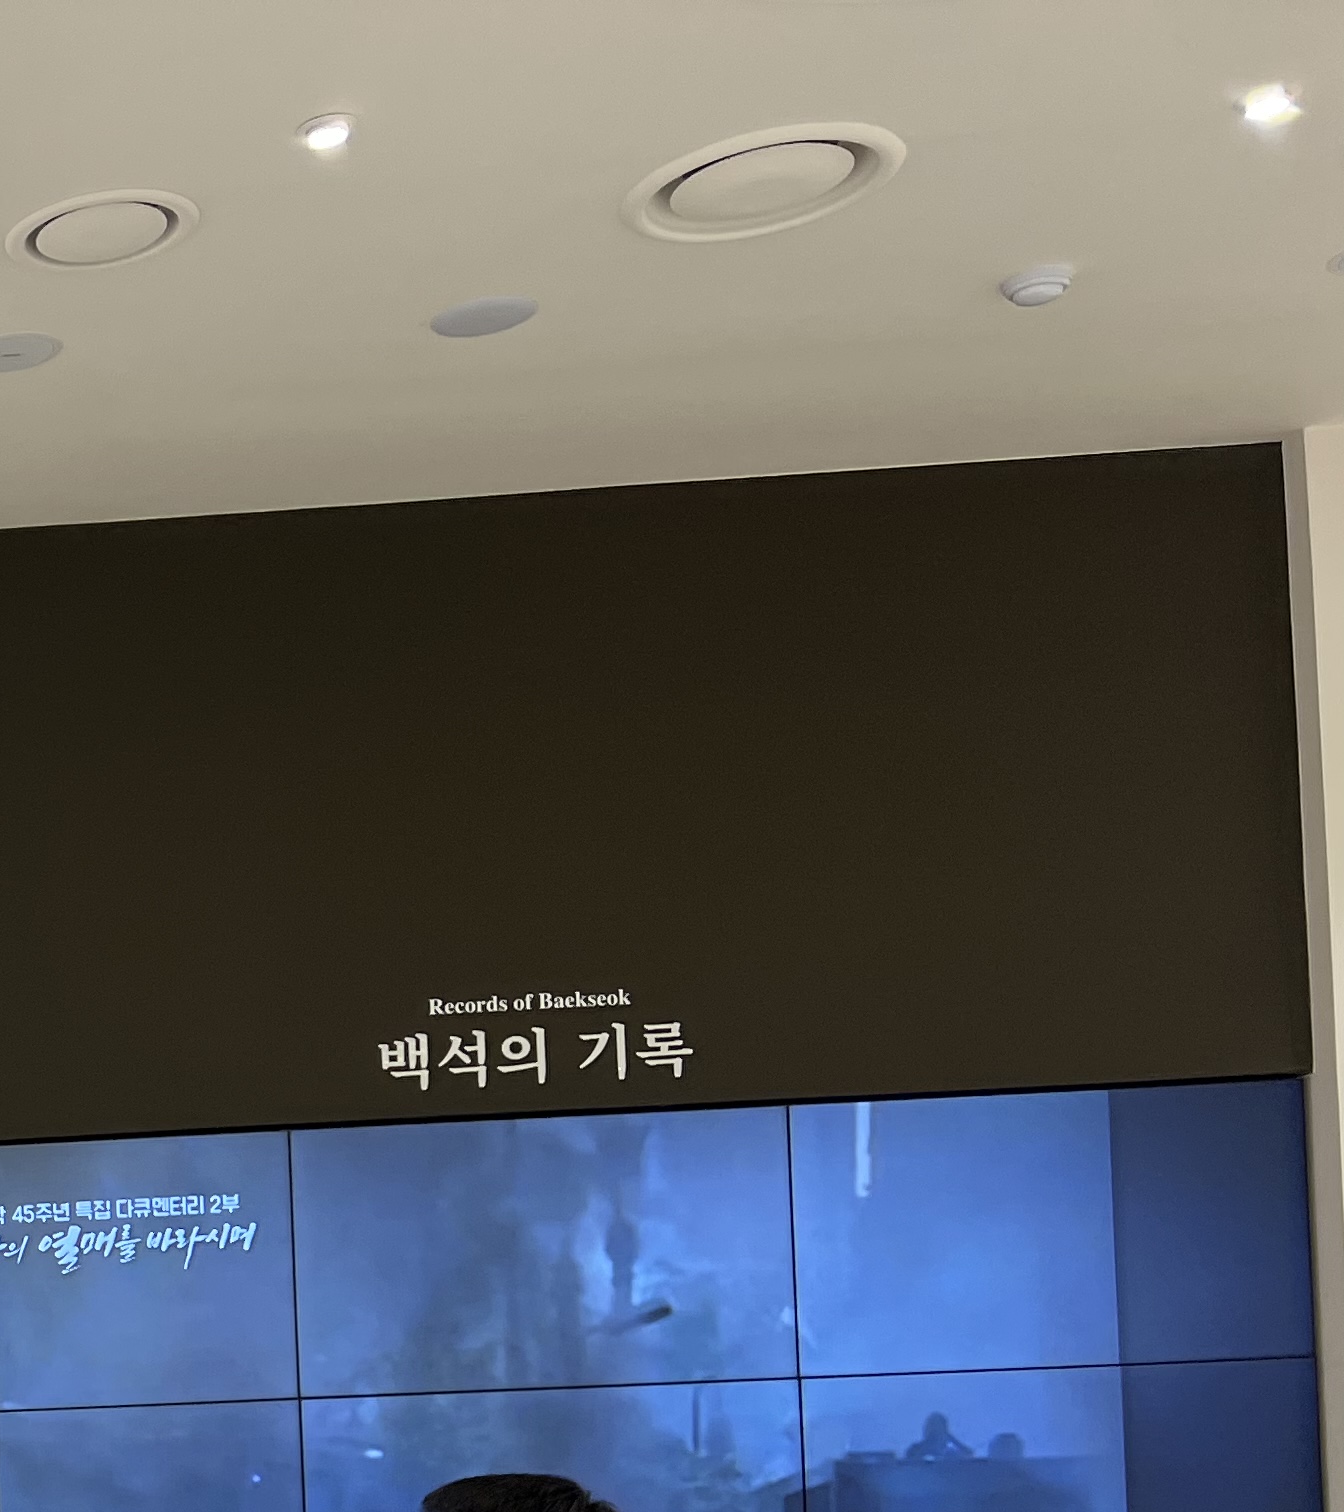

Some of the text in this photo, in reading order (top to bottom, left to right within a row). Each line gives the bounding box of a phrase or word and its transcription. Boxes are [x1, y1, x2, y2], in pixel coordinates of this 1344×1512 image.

[429, 988, 632, 1016] Records of Baekseok
[377, 1021, 694, 1091] 백석의 기록
[11, 1201, 71, 1224] 45주년
[75, 1199, 111, 1221] 특집
[115, 1195, 205, 1219] 다큐멘터리
[209, 1193, 240, 1214] 2부
[38, 1224, 142, 1275] 열매를
[146, 1222, 257, 1270] 바라시며
